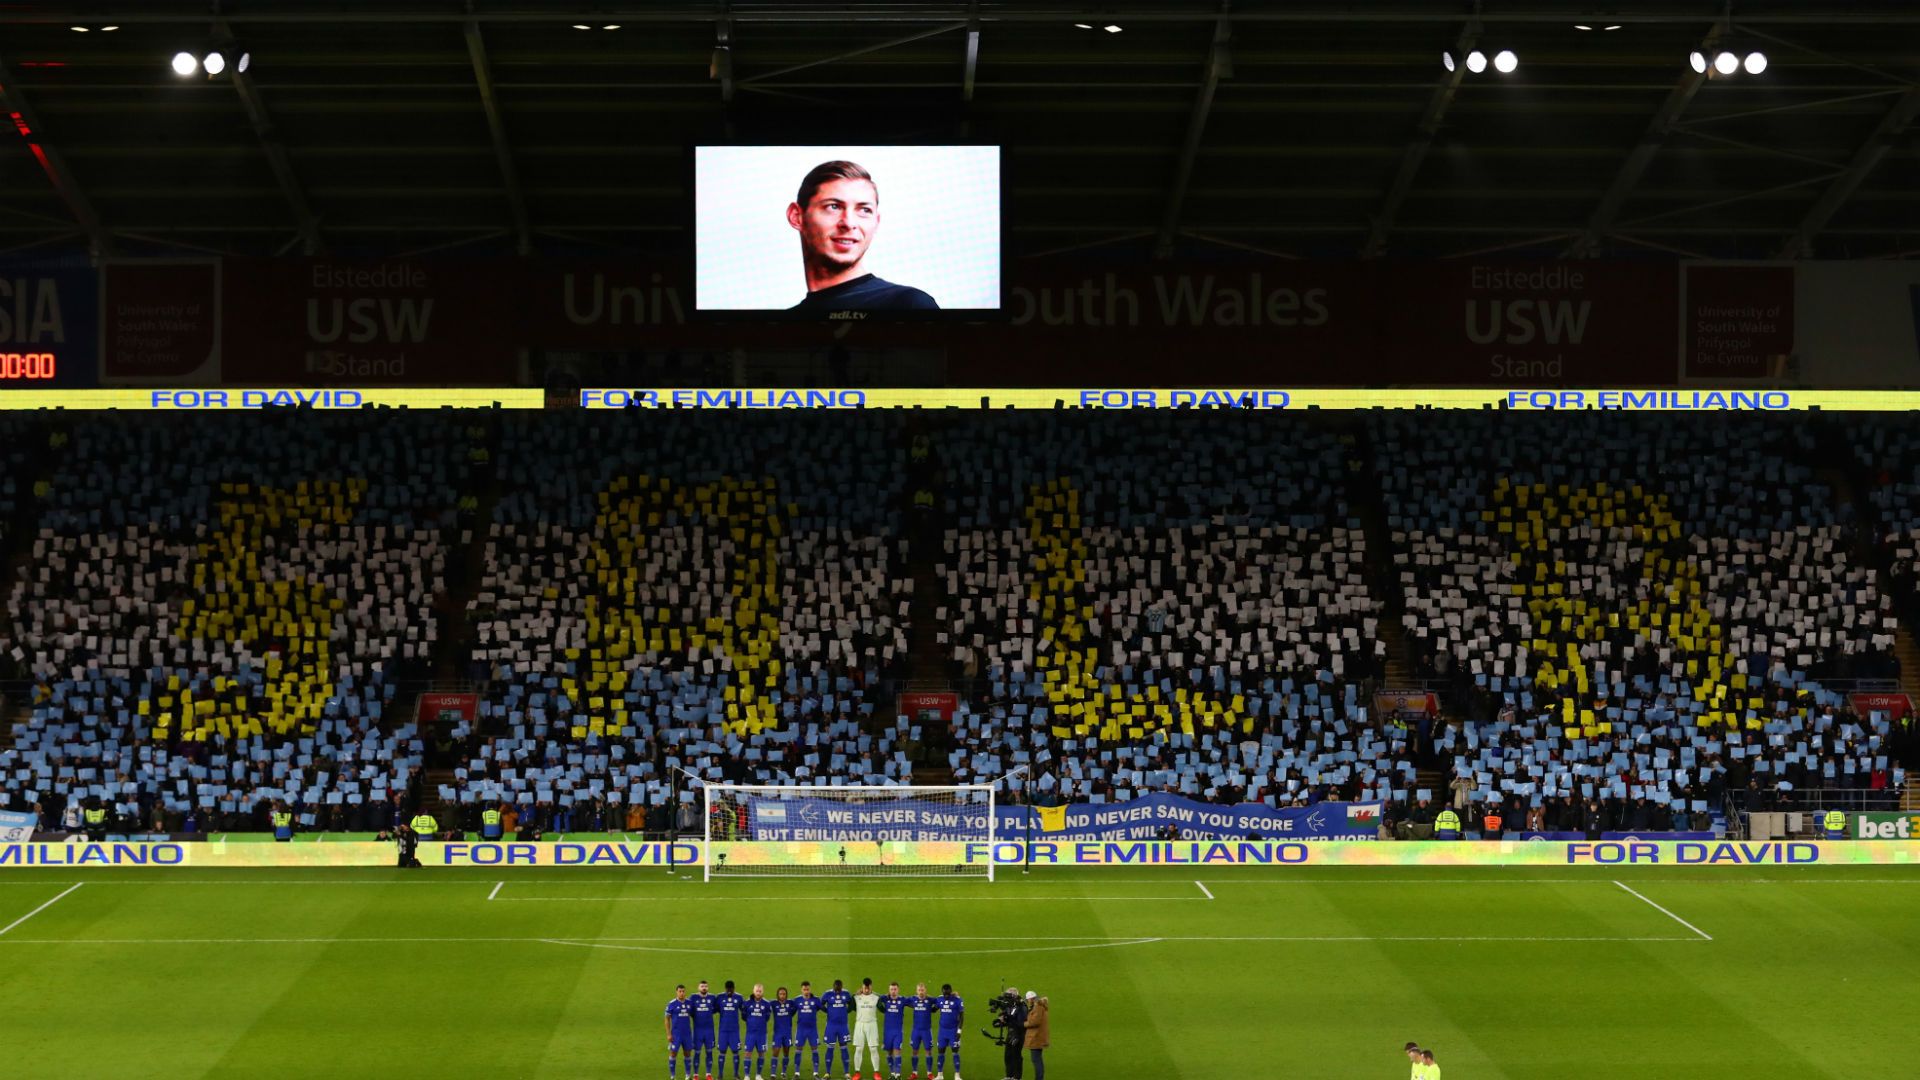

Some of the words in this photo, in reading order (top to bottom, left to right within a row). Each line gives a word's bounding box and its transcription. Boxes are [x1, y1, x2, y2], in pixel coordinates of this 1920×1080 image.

[312, 263, 427, 288] Eisteddle
[1472, 266, 1584, 291] Eisteddle
[1154, 273, 1329, 327] Wales
[117, 304, 184, 318] University
[1697, 305, 1764, 320] University
[1766, 305, 1780, 318] of
[117, 319, 155, 332] South
[159, 319, 198, 332] Wales
[306, 297, 435, 344] USW
[1464, 299, 1591, 345] USW
[1697, 321, 1736, 333] South
[1739, 321, 1776, 333] Wales
[333, 352, 405, 376] Stand
[1490, 355, 1562, 378] Stand
[1717, 352, 1759, 366] Cymru
[152, 391, 227, 408] FOR
[243, 391, 362, 408] DAVID
[582, 390, 658, 408] FOR
[673, 390, 866, 408] EMILIANO
[1081, 391, 1157, 408] FOR
[1171, 391, 1289, 408] DAVID
[1509, 391, 1584, 408] FOR
[1599, 391, 1790, 408] EMILIANO
[440, 697, 461, 705] USW
[919, 697, 939, 705] USW
[827, 810, 853, 823] WE
[859, 810, 916, 824] NEVER
[922, 811, 958, 827] SAW
[964, 815, 999, 829] YOU
[1067, 815, 1090, 828] ND
[1096, 807, 1152, 825] NEVER
[1157, 805, 1194, 822] SAW
[1199, 812, 1234, 828] YOU
[1238, 816, 1293, 831] SCORE
[1858, 815, 1920, 838] bet3
[758, 829, 789, 841] BUT
[794, 829, 872, 841] EMILIANO
[878, 829, 912, 841] OUR
[1101, 830, 1125, 841] WE
[445, 845, 537, 864] FOR
[556, 845, 699, 864] DAVID
[967, 844, 1057, 863] FOR
[1076, 844, 1308, 863] EMILIANO
[1568, 844, 1659, 863] FOR
[1677, 844, 1819, 863] DAVID
